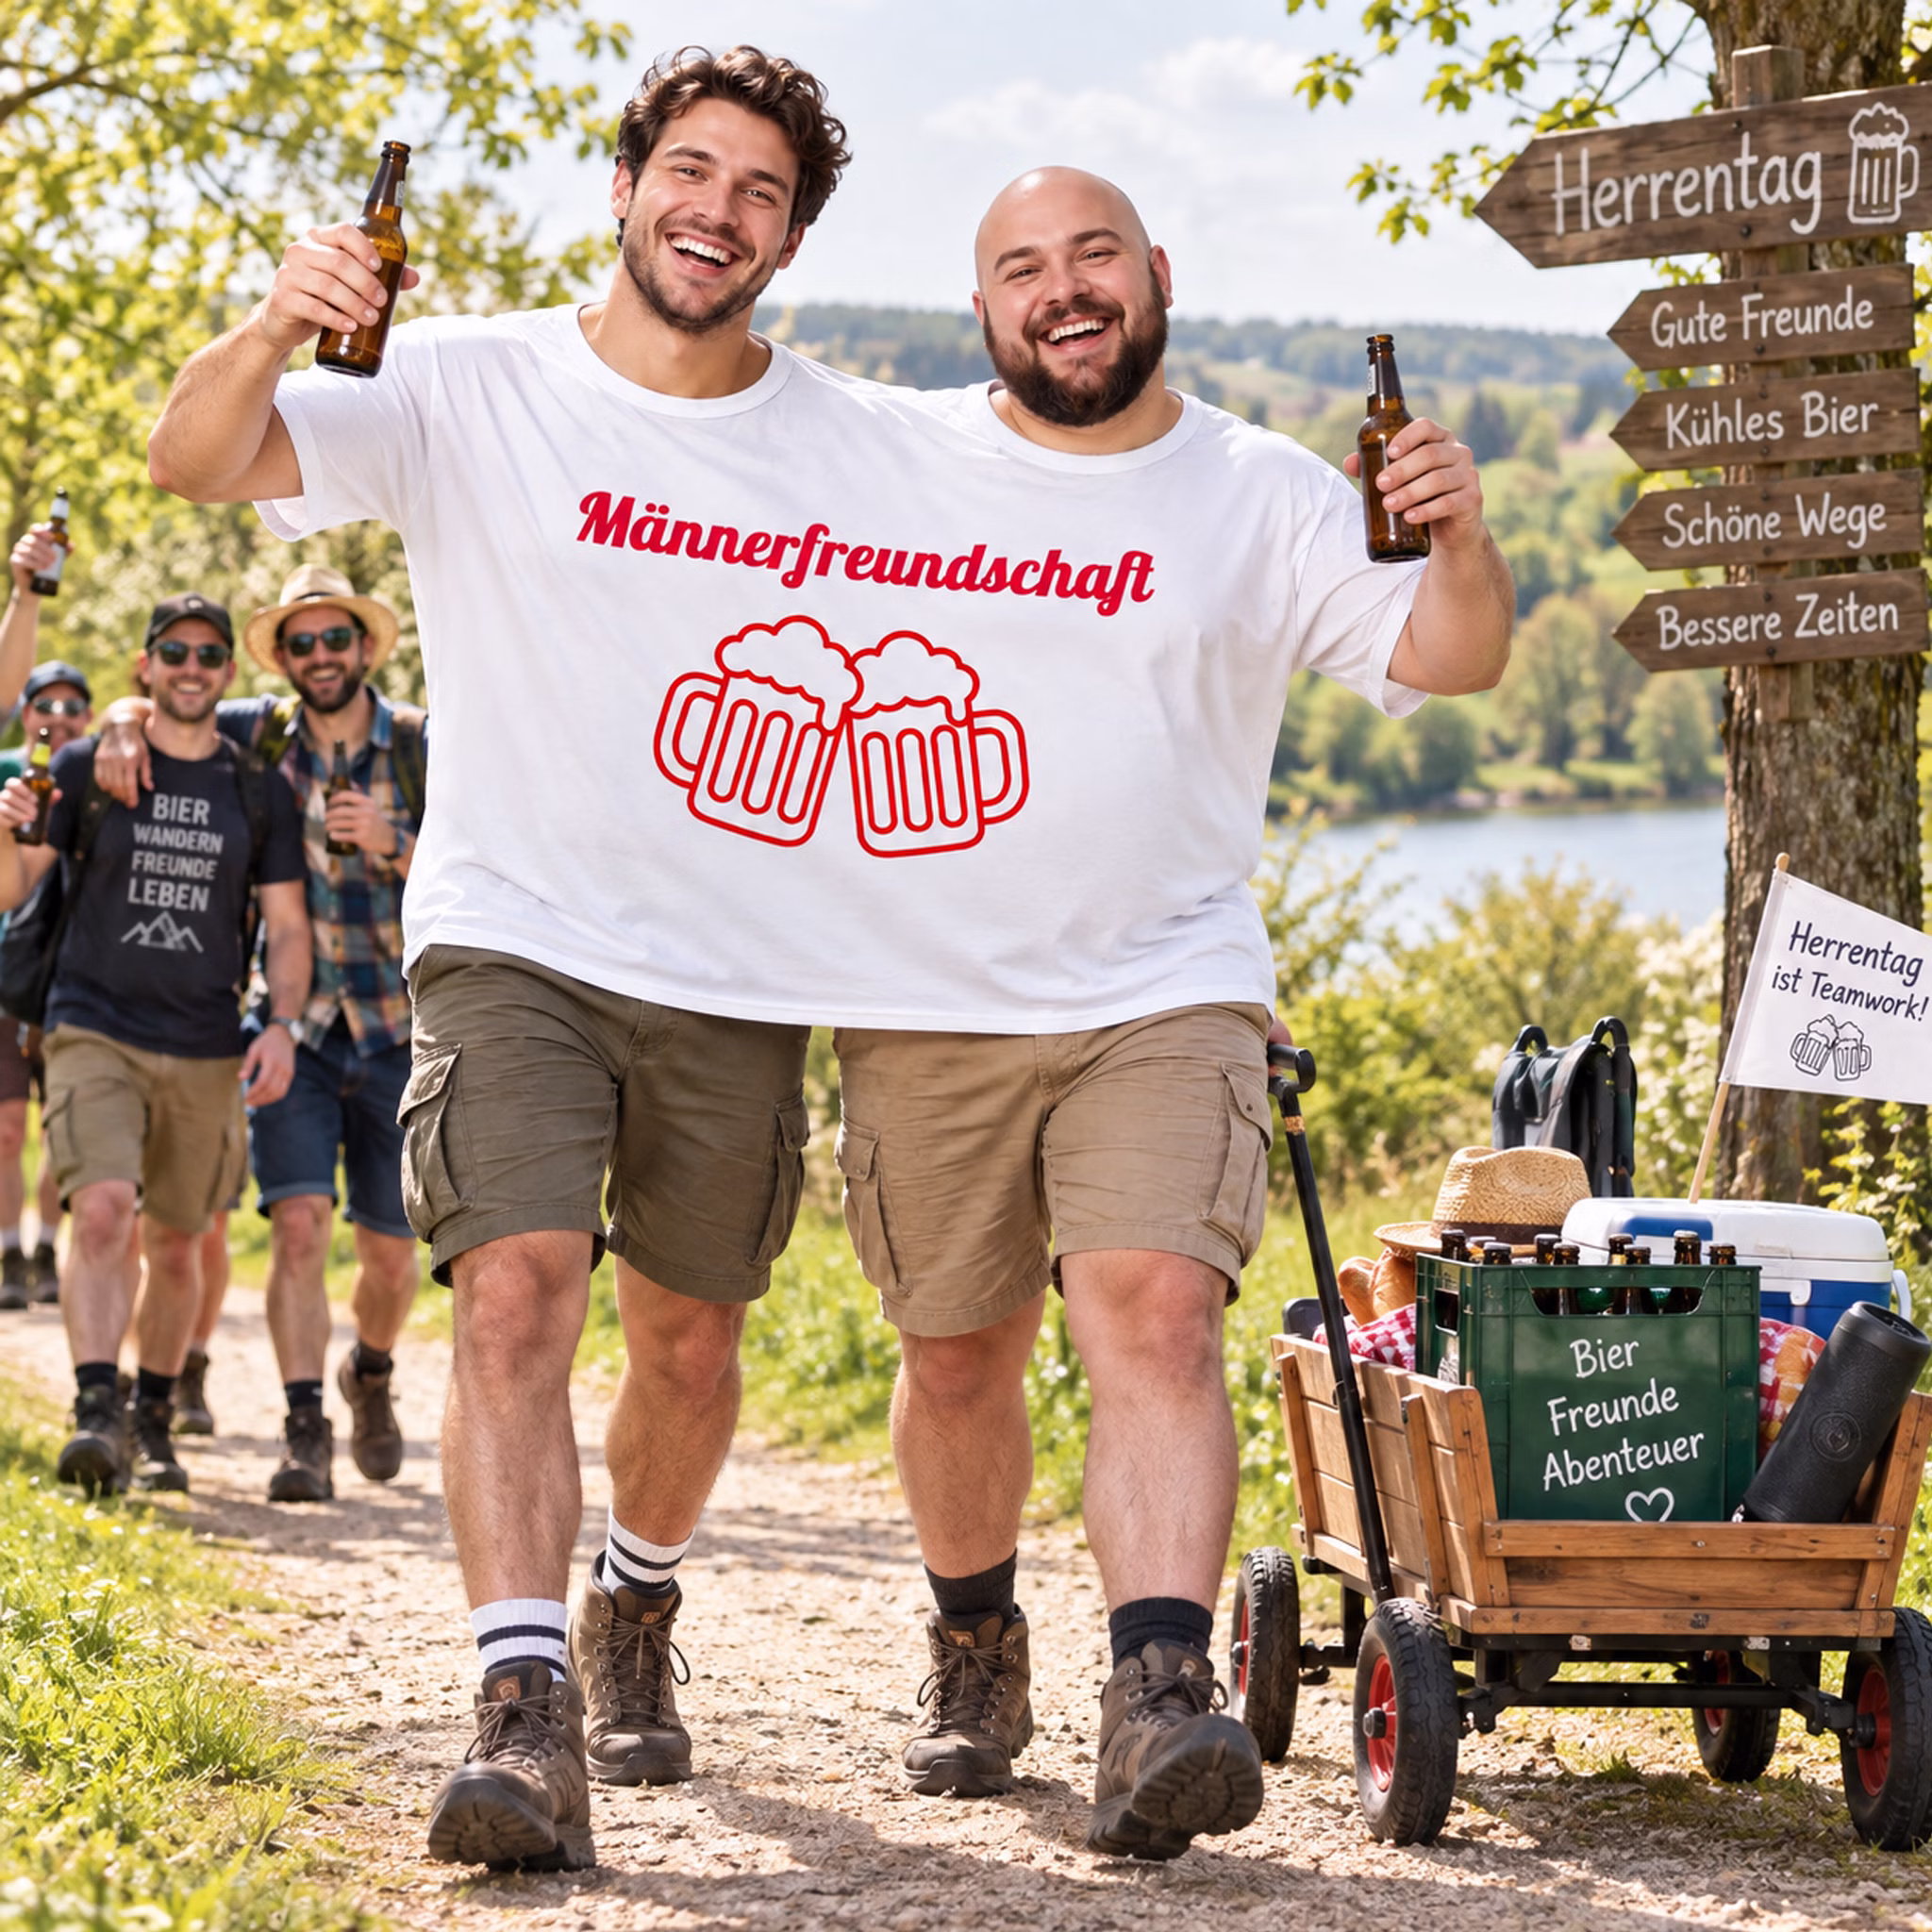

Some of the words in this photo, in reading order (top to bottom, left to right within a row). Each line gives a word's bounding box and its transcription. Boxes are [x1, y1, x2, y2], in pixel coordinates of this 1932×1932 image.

[1550, 132, 1823, 236] Herrentag
[1651, 303, 1727, 349] Gute
[1740, 285, 1874, 341] Freunde
[1665, 398, 1784, 450] Kühles
[1801, 390, 1878, 439] Bier
[1662, 501, 1781, 549] Schöne
[1795, 492, 1887, 549] Wege
[576, 491, 1155, 617] Männerfreundschaft
[1656, 606, 1781, 651] Bessere
[1794, 591, 1899, 638] Zeiten
[152, 793, 210, 825] BIER
[131, 850, 218, 880] FREUNDE
[133, 823, 224, 855] WANDERN
[127, 877, 209, 912] LEBEN
[1789, 921, 1924, 987] Herrentag
[1772, 966, 1803, 993] ist
[1810, 972, 1929, 1022] Teamwork!
[1570, 1339, 1640, 1378] Bier
[1547, 1377, 1679, 1436] Freunde
[1543, 1433, 1704, 1491] Abenteuer
